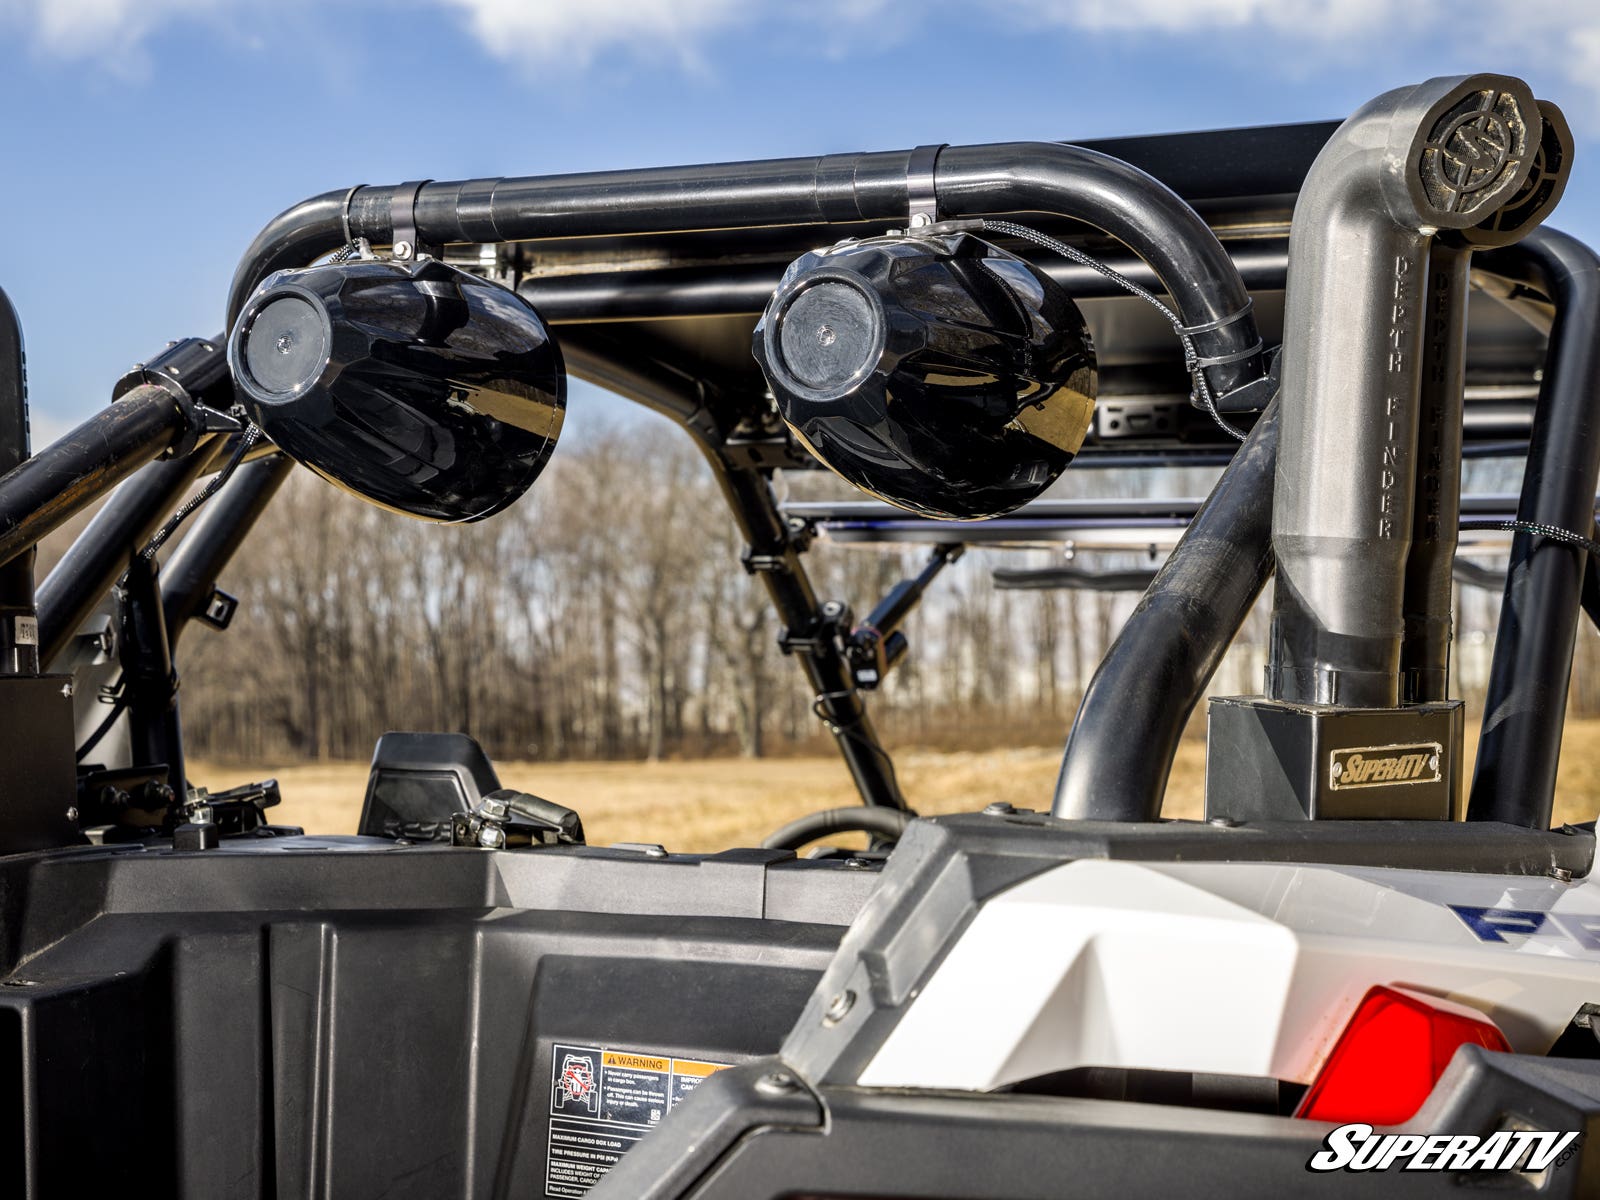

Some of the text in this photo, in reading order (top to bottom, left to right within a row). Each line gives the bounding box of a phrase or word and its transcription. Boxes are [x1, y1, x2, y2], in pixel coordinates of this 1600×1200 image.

[1379, 255, 1409, 540] DEPTH FINDER
[1341, 753, 1430, 783] SUPERATV
[617, 1056, 663, 1070] WARNING
[552, 1134, 577, 1142] MAXIMUM
[577, 1137, 596, 1145] CARGO
[595, 1139, 607, 1147] BOX
[563, 1150, 589, 1158] PRESSURE
[550, 1161, 576, 1169] MAXIMUM
[575, 1164, 596, 1172] WEIGHT
[550, 1167, 575, 1176] INCLUDES
[561, 1187, 583, 1195] Operation
